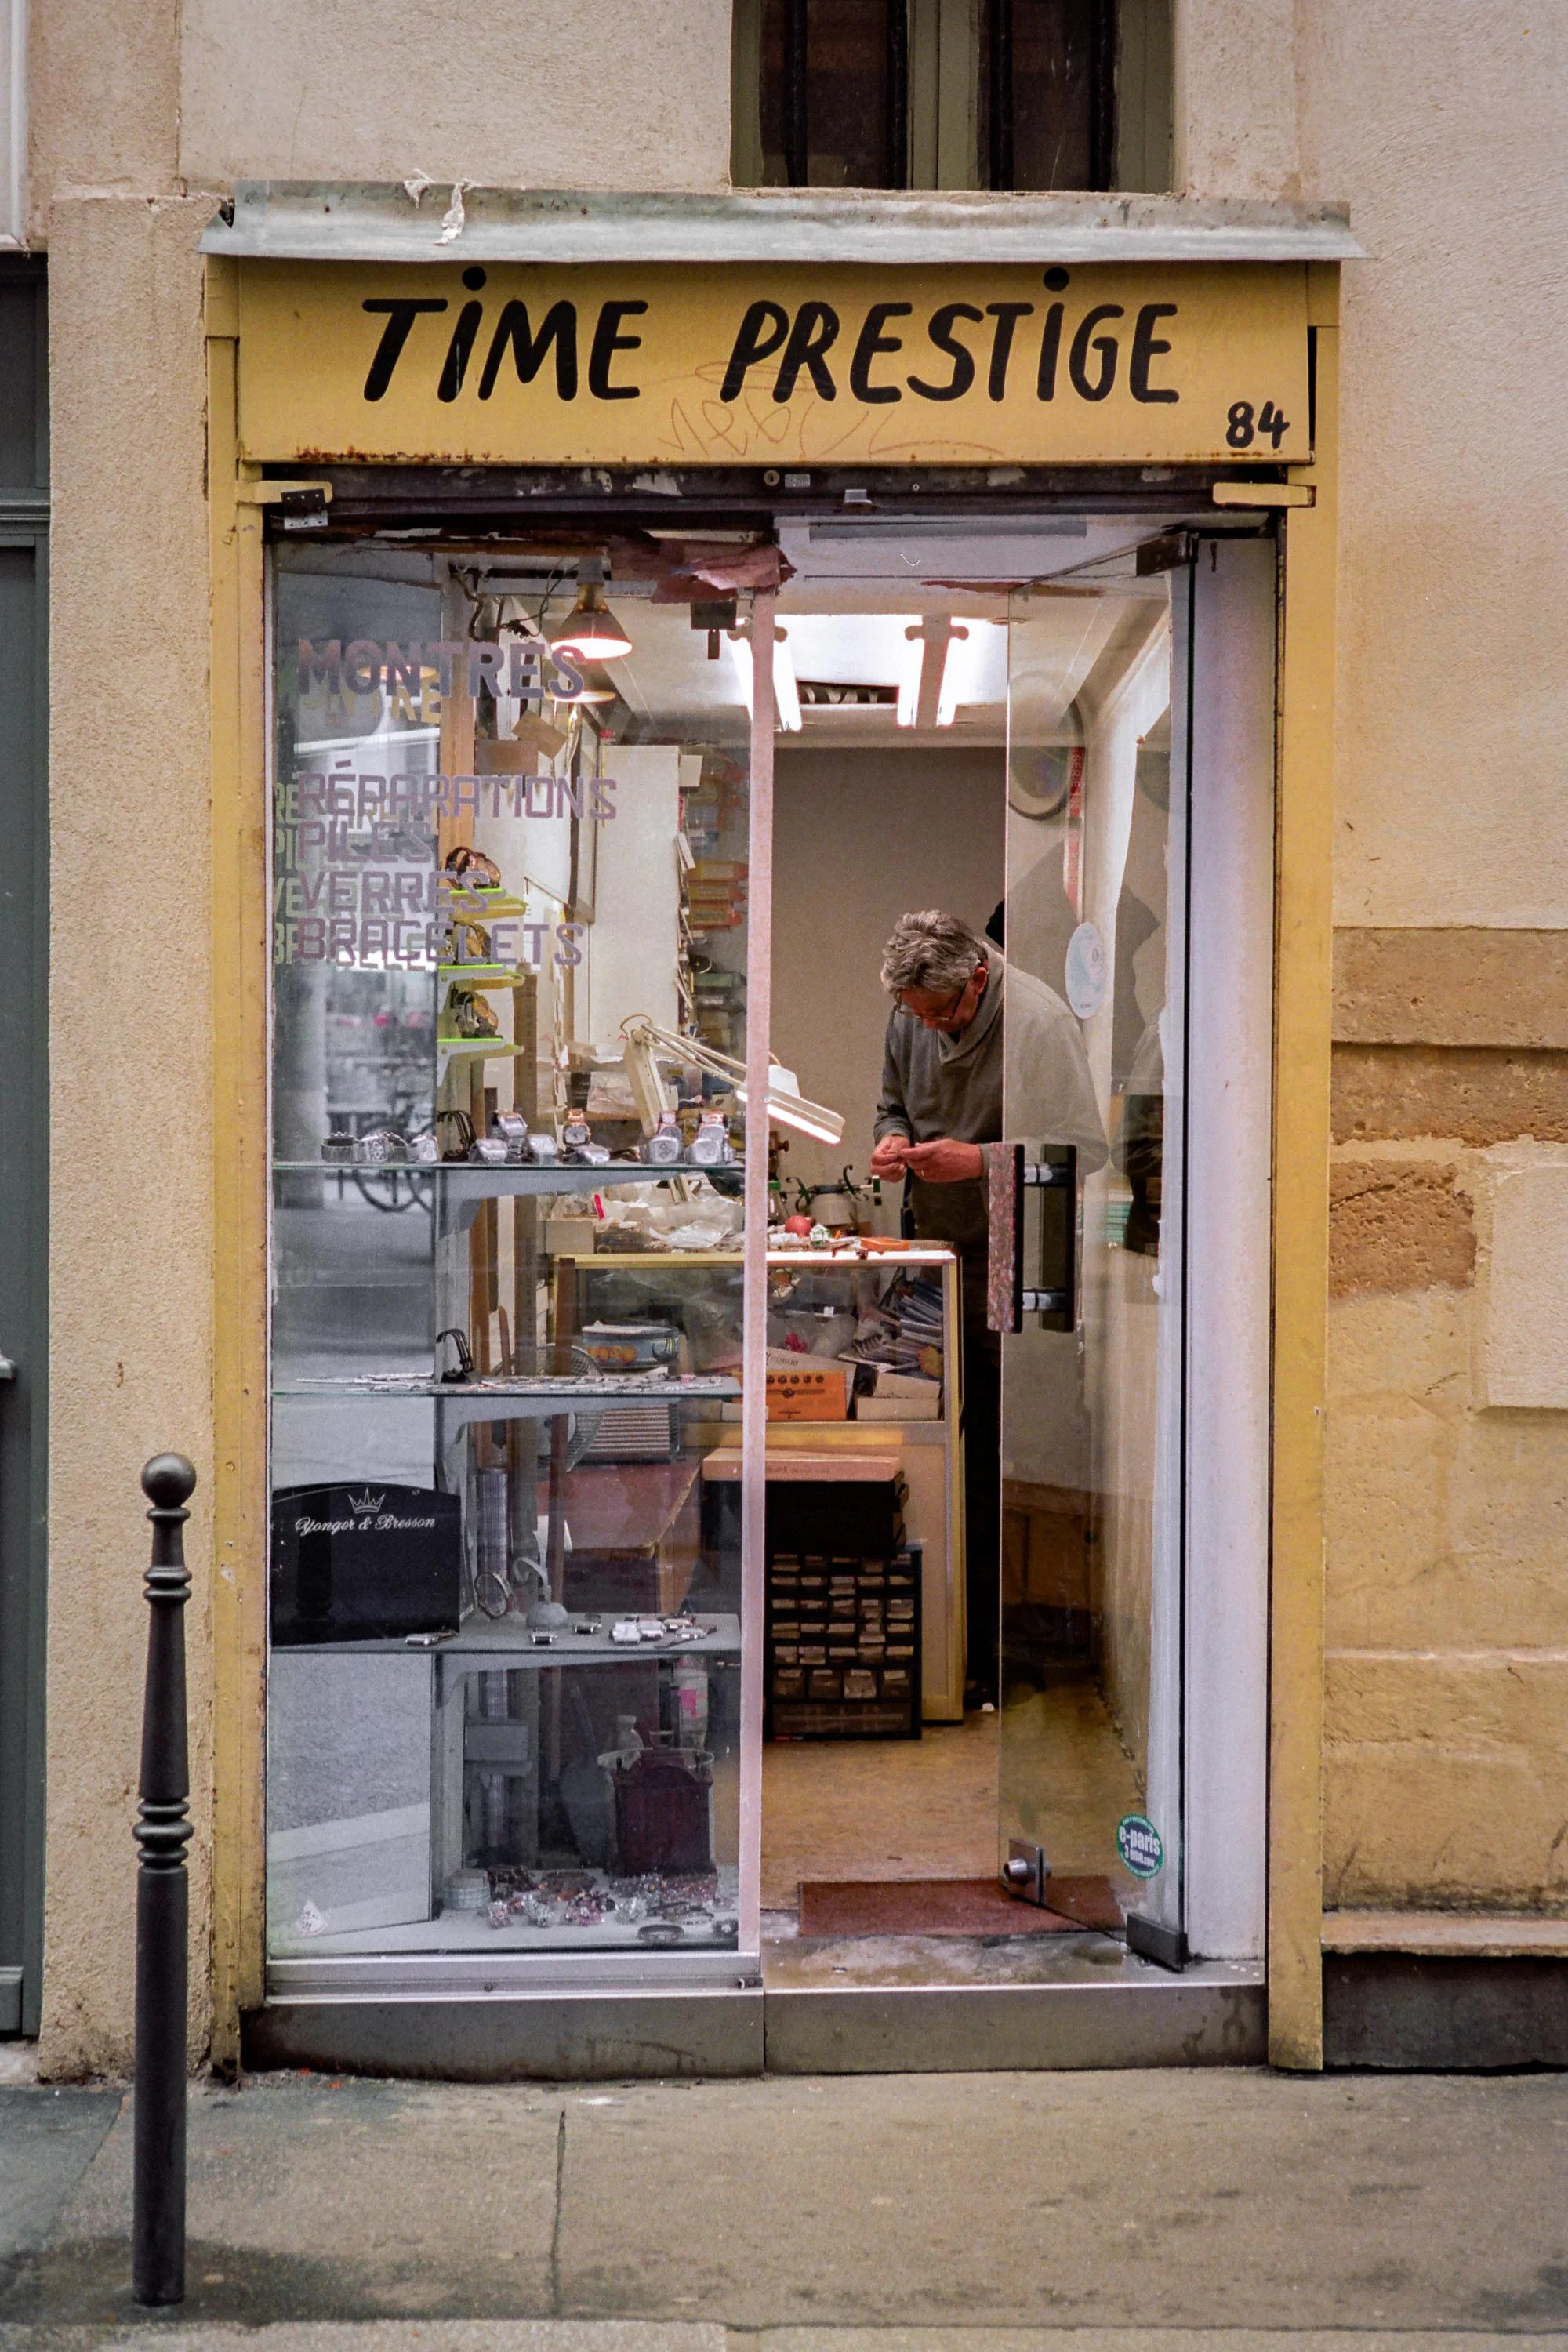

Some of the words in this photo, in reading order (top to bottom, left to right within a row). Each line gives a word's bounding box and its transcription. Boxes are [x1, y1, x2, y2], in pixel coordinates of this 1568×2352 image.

[1225, 401, 1290, 449] 84
[298, 639, 586, 699] MONTRES
[297, 759, 618, 821] RÉPARATIONS
[298, 821, 433, 864] PILES
[299, 870, 489, 915] VERRES
[297, 917, 584, 967] BRACELETS
[295, 1516, 355, 1537] Yonger
[358, 1516, 372, 1530] &
[374, 1514, 436, 1530] Bresson
